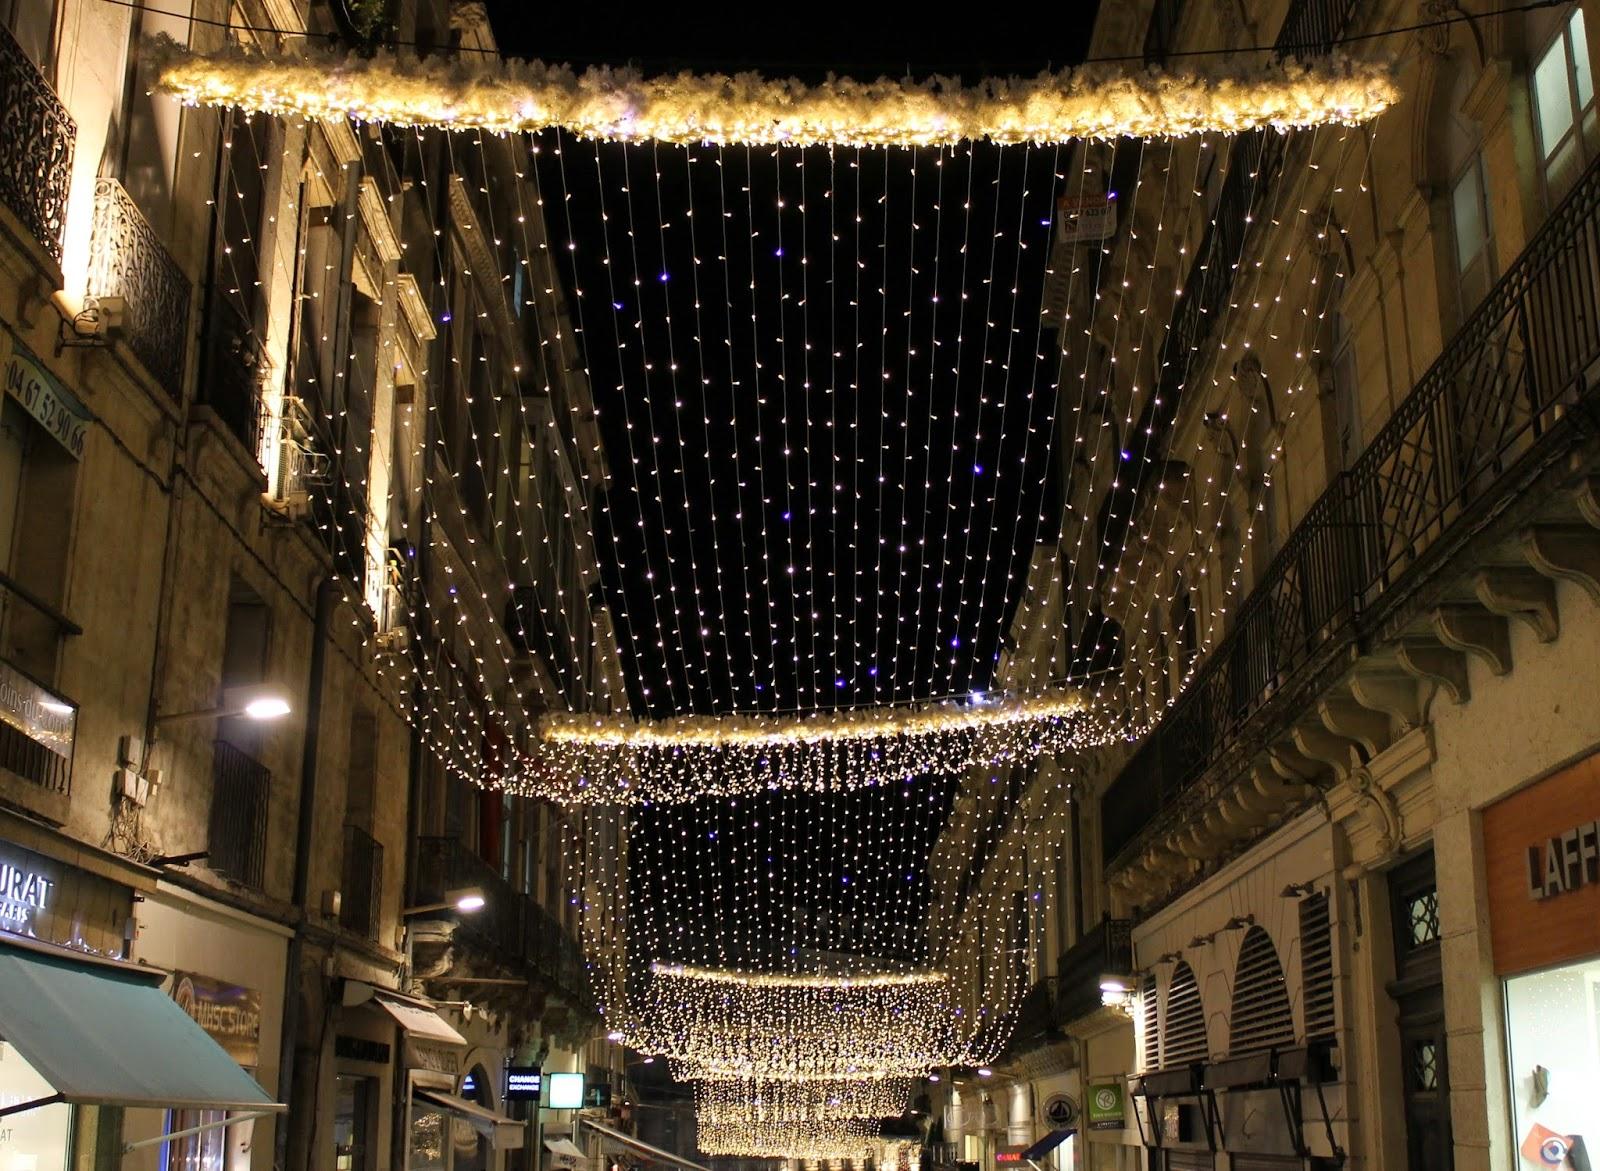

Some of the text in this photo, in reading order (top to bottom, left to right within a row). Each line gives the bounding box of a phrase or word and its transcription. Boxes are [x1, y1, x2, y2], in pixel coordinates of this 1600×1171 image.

[8, 360, 87, 455] 04 67 52 90 66
[229, 1006, 259, 1038] STORE
[508, 1075, 540, 1084] CHANGE
